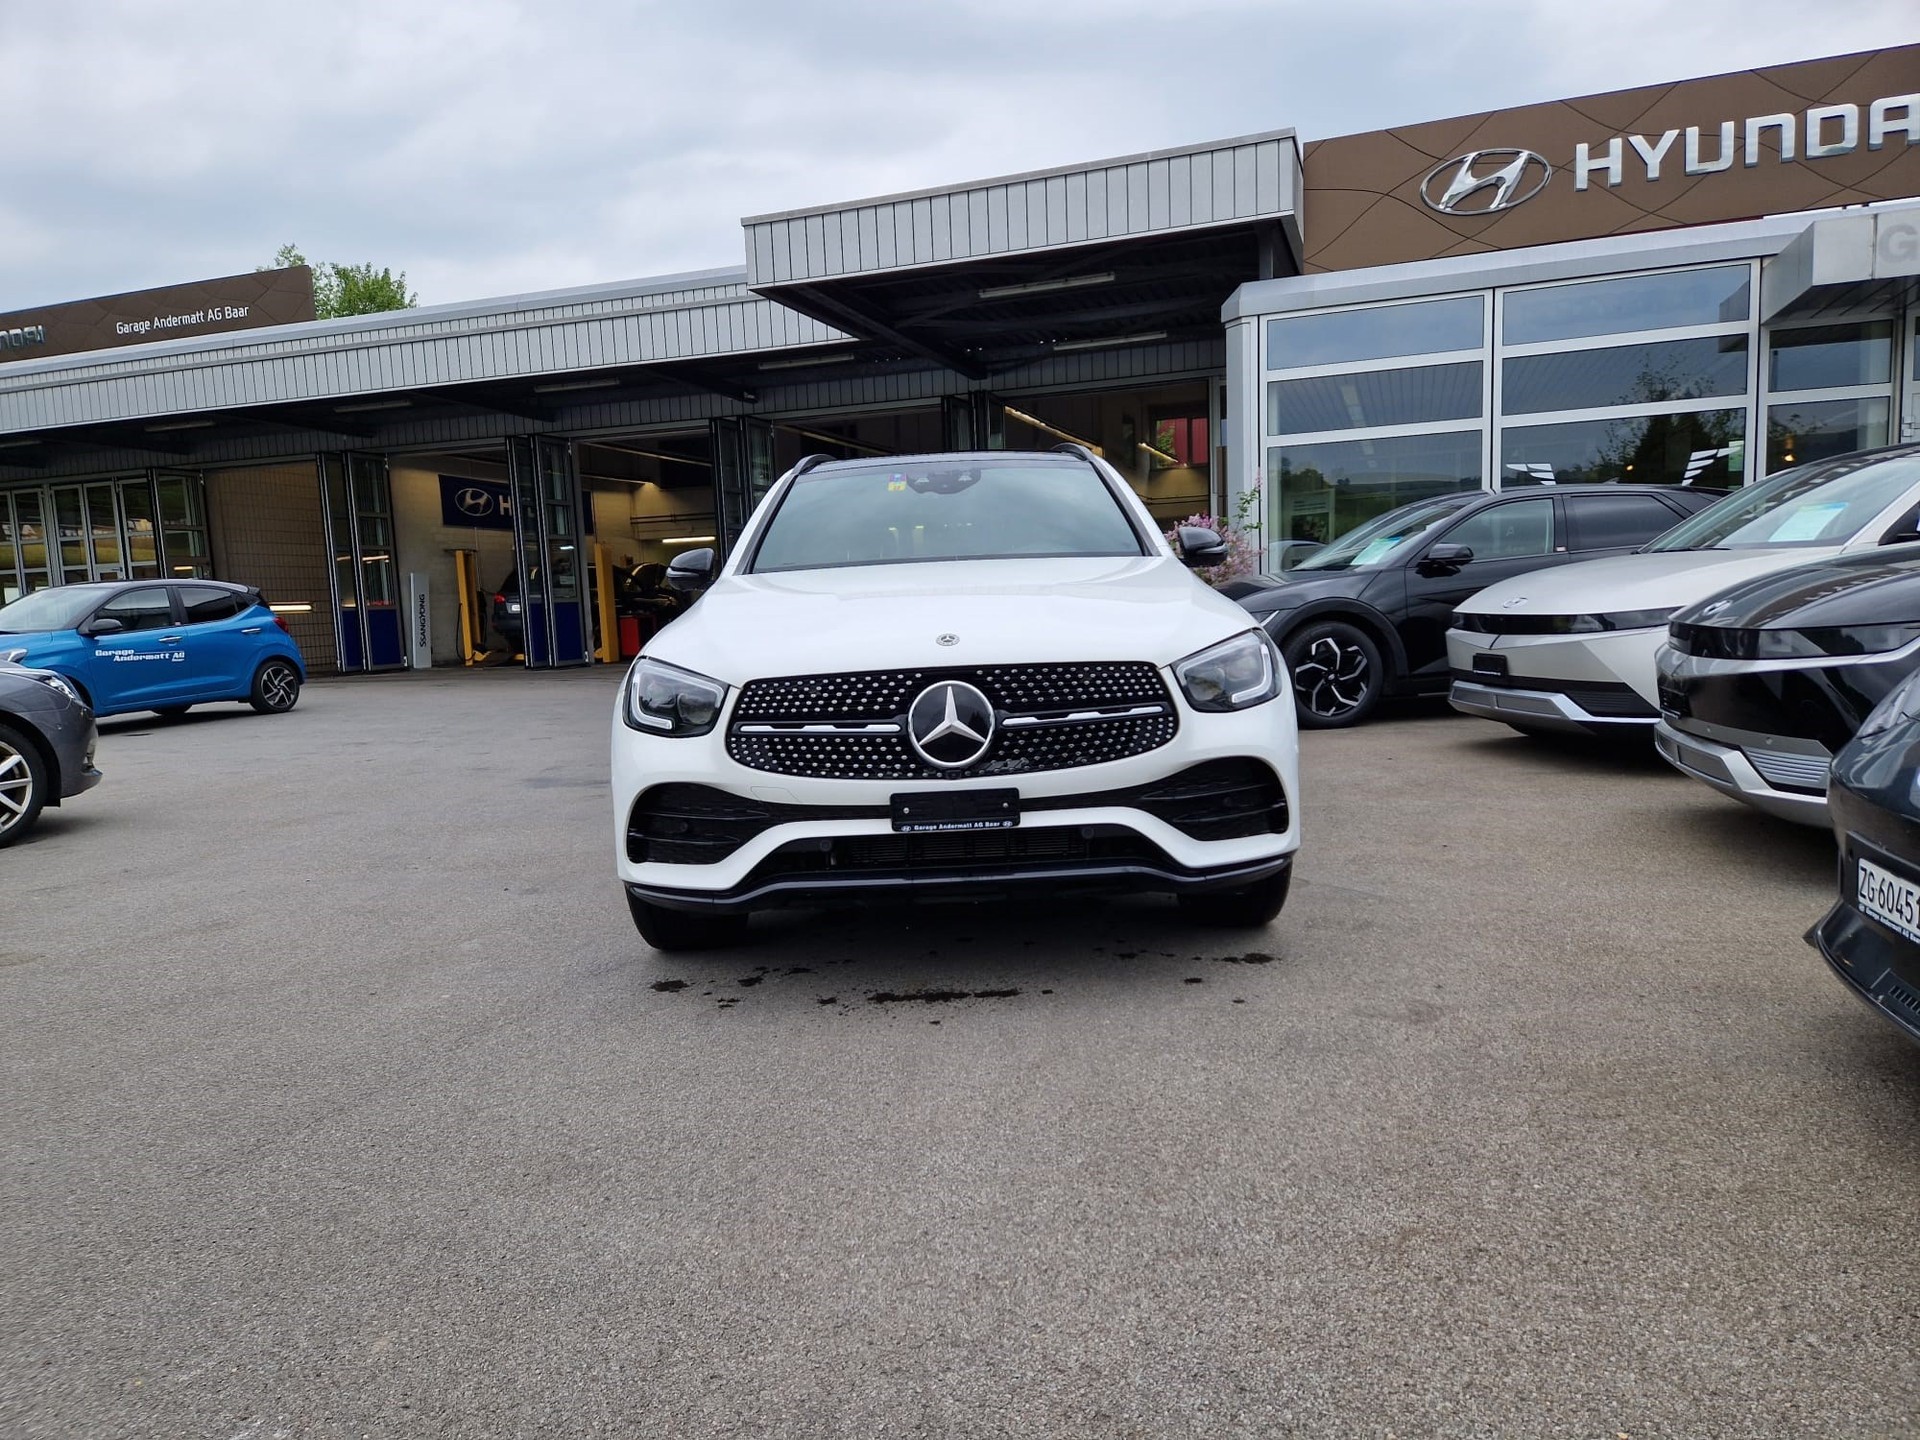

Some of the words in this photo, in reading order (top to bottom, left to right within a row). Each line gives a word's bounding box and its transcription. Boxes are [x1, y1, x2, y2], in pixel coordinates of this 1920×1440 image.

[116, 321, 151, 335] Garage
[153, 311, 204, 329] Andermatt
[207, 308, 222, 322] AG
[225, 306, 250, 318] Baar
[419, 593, 427, 648] SSANGYONG
[95, 649, 135, 657] Garage
[113, 653, 170, 662] Andermatt
